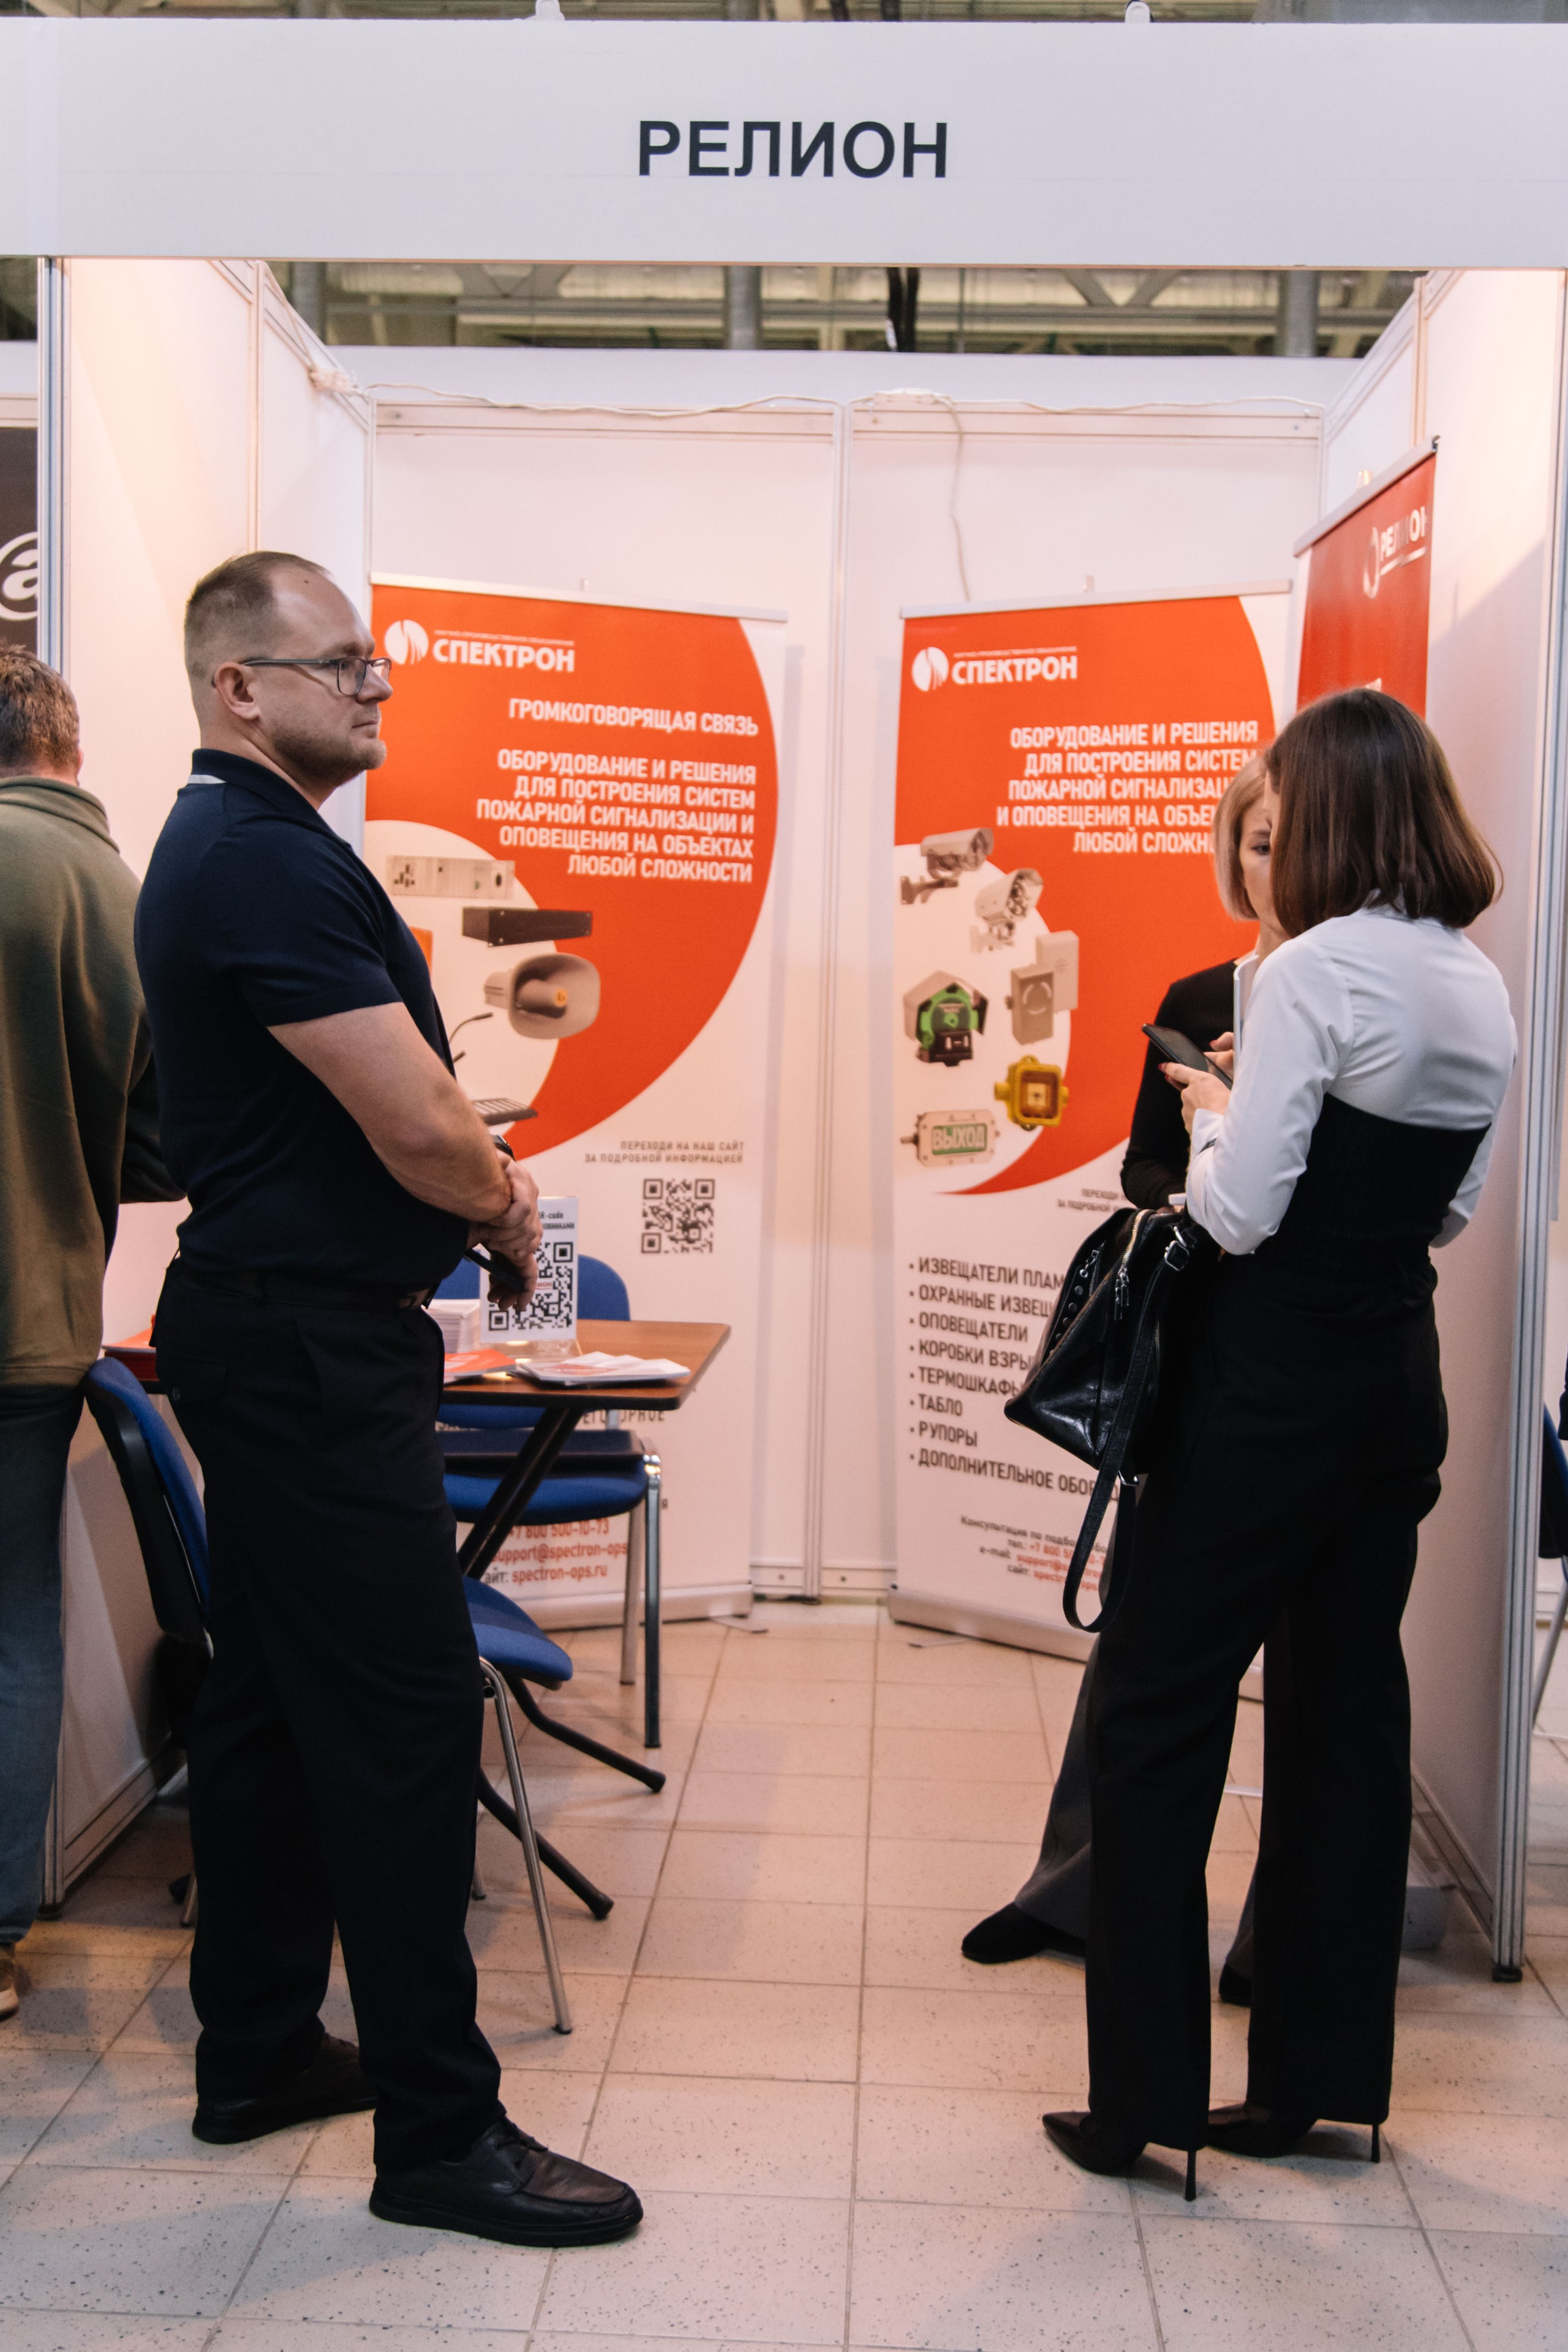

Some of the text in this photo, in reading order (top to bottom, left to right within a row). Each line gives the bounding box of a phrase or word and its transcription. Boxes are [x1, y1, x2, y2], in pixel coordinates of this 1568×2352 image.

[639, 120, 948, 178] РЕЛИОН
[433, 638, 575, 673] СПЕКТРОН
[951, 655, 1078, 684] СПЕКТРОН
[509, 698, 758, 736] ГРОМКОГОВОРЯЩАЯ СВЯЗЬ
[1011, 720, 1259, 750] ОБОРУДОВАНИЕ И РЕШЕНИЯ
[498, 748, 756, 785] ОБОРУДОВАНИЕ И РЕШЕНИЯ
[1024, 753, 1063, 777] ДЛЯ
[1066, 750, 1181, 774] ПОСТРОЕНИЯ
[514, 775, 755, 809] ДЛЯ ПОСТРОЕНИЯ СИСТЕМ
[1009, 774, 1107, 801] ПОЖАРНОЙ
[477, 797, 754, 835] ПОЖАРНОЙ СИГНАЛИЗАЦИИ И
[997, 805, 1009, 827] И
[1012, 805, 1131, 830] ОПОВЕЩЕНИЯ
[1135, 805, 1160, 826] НА
[499, 826, 753, 858] ОПОВЕЩЕНИЯ НА ОБЪЕКТАХ
[1073, 826, 1214, 854] ЛЮБОЙ СЛОЖН
[567, 853, 753, 883] ЛЮБОЙ СЛОЖНОСТИ
[620, 1139, 744, 1151] ПЕРЕХОДИ НА НАШ САЙТ
[932, 1126, 985, 1151] ВЫХОД
[585, 1152, 744, 1164] ЗА ПОДРОБНОЙ ИНФОРМАЦИЕЙ
[919, 1256, 1065, 1291] ИЗВЕЩАТЕЛИ ПЛАМ
[919, 1284, 996, 1311] ОХРАННЫЕ
[919, 1311, 1028, 1343] ОПОВЕЩАТЕЛИ
[919, 1339, 984, 1365] КОРОБКИ
[919, 1393, 963, 1417] ТАБЛО
[919, 1420, 978, 1448] РУПОРЫ
[919, 1447, 1054, 1490] ДОПОЛНИТЕЛЬНОЕ
[961, 1515, 1028, 1538] Консультация
[1031, 1531, 1042, 1540] по
[492, 1542, 627, 1566] support@spectron-ops
[484, 1565, 608, 1586] айт: spectron-ops.ru
